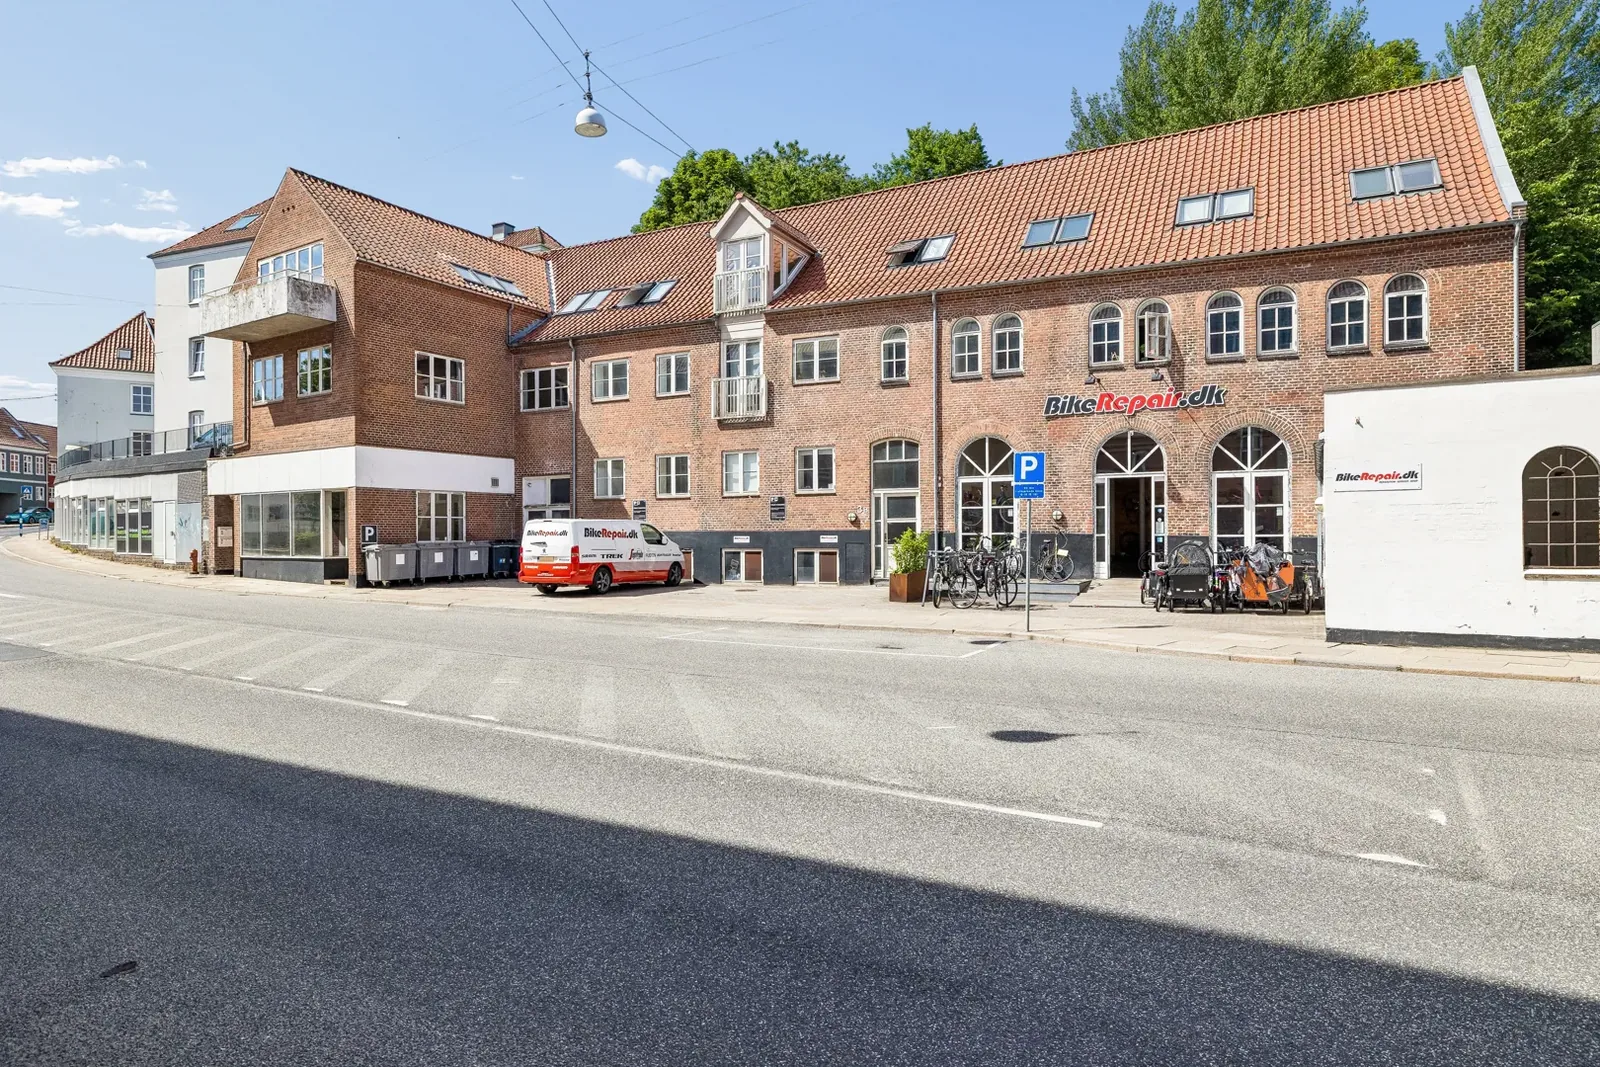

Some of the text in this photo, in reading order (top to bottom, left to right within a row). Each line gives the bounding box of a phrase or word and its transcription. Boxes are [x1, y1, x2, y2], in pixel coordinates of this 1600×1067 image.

[1043, 384, 1227, 416] BikeRepair.dk
[1021, 456, 1038, 480] P
[1335, 470, 1419, 482] BikeRepair.dk
[365, 526, 375, 541] P
[527, 529, 568, 537] BikeRepair.dk
[584, 527, 638, 540] BikeRepair.dk
